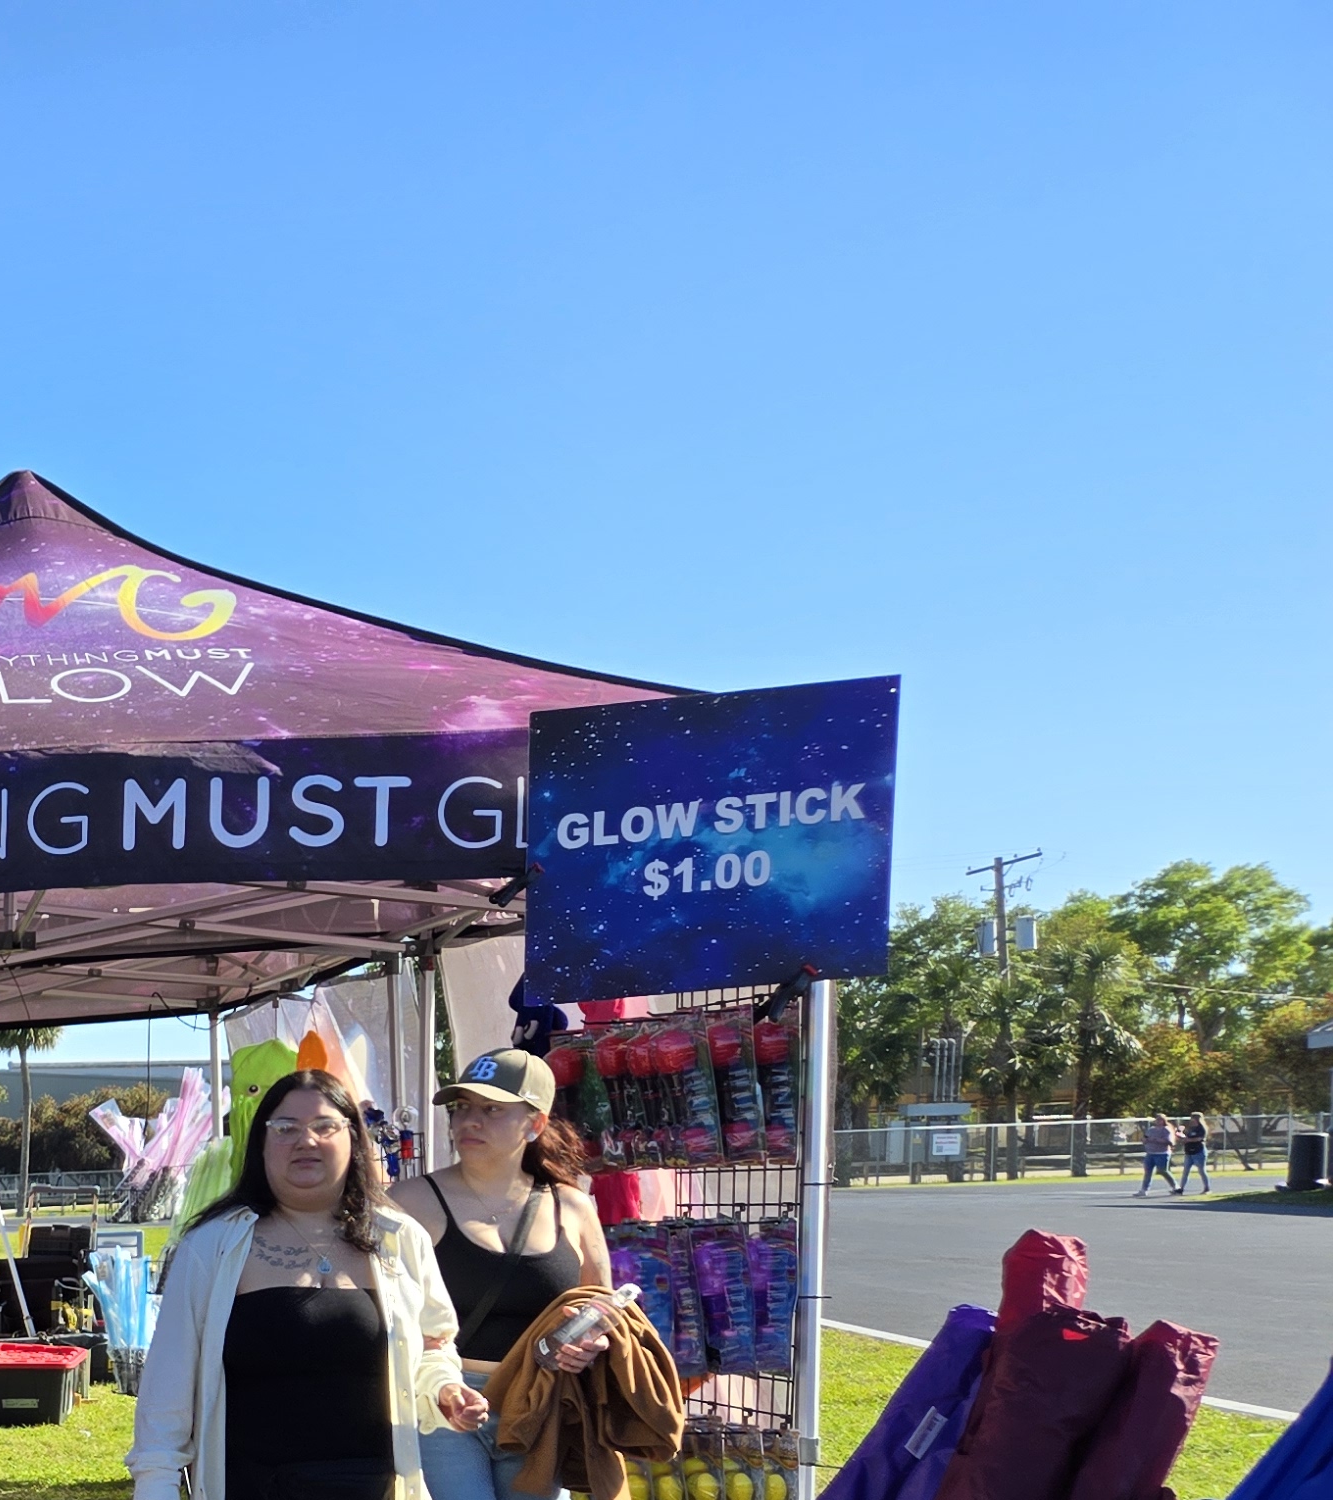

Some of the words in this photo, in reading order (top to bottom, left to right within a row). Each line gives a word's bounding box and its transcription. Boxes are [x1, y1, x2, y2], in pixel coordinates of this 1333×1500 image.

[144, 647, 253, 661] MUST
[122, 775, 412, 850] MUST
[556, 800, 703, 849] GLOW
[714, 782, 866, 834] STICK
[642, 850, 771, 900] $1.00
